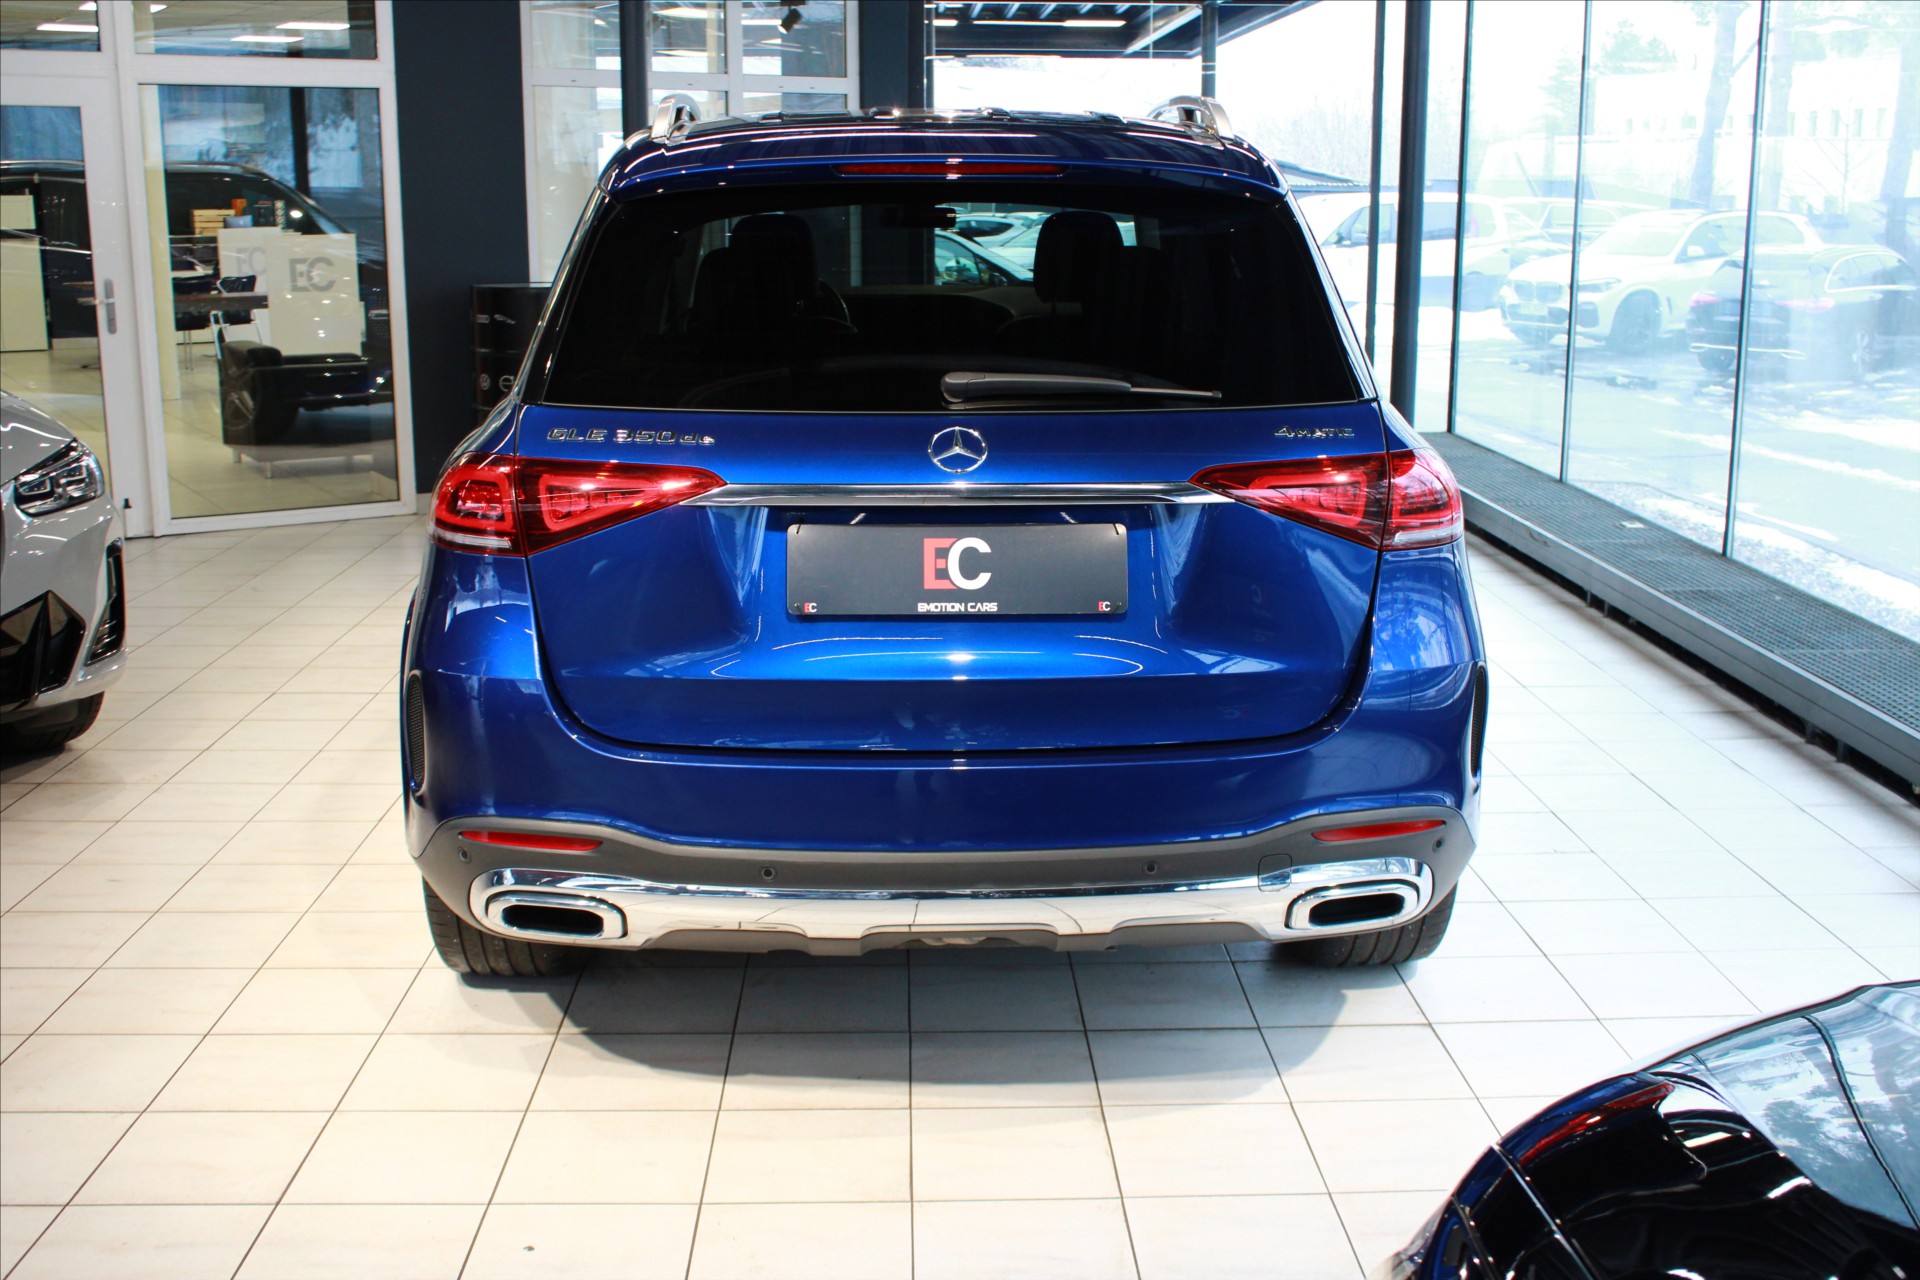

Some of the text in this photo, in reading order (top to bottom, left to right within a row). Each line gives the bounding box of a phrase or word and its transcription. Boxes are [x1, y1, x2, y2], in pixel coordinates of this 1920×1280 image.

[289, 256, 336, 292] EC
[547, 427, 608, 443] GLE
[613, 429, 676, 444] 350
[1274, 426, 1355, 439] 4MATIC
[923, 537, 992, 590] EC
[804, 602, 818, 613] EC
[917, 602, 998, 612] EMOTION CARS
[1098, 601, 1111, 611] EC
